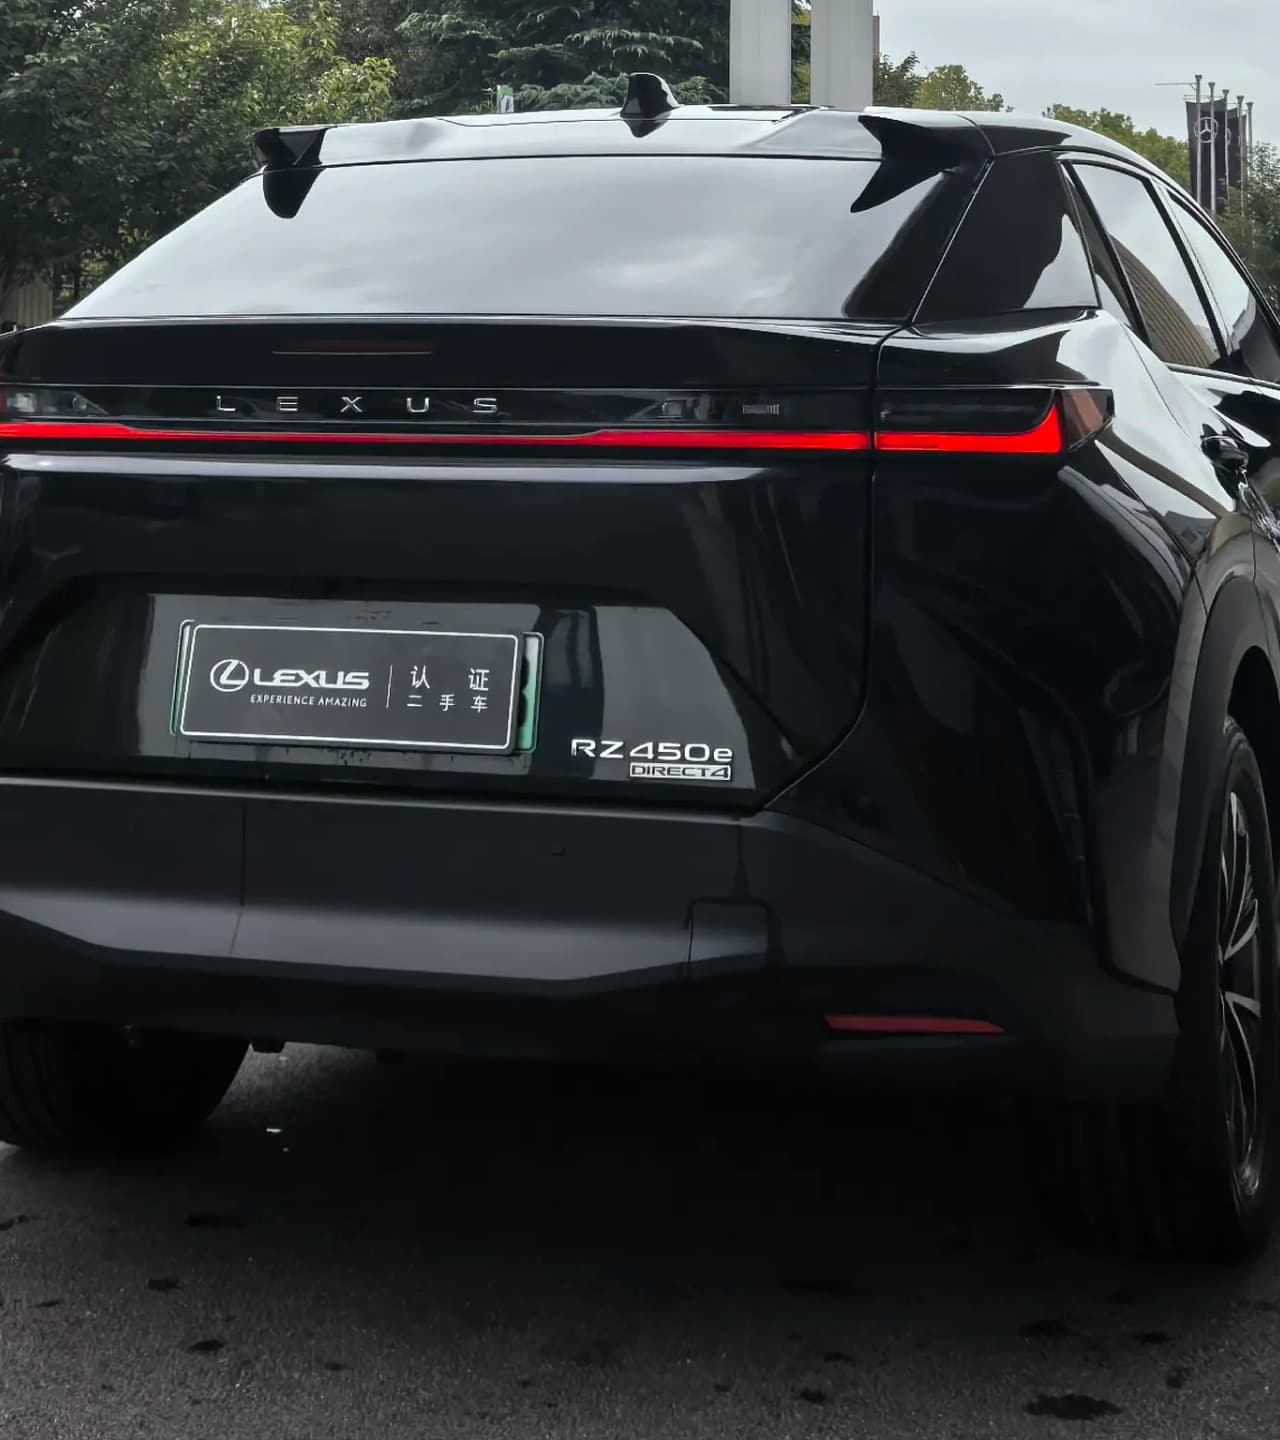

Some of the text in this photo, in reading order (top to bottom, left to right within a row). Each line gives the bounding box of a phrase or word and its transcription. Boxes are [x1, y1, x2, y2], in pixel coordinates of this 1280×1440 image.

[216, 395, 498, 414] LEXUS
[253, 668, 370, 690] LEXUS
[250, 694, 367, 708] EXPERIENCE AMAZING
[406, 693, 489, 713] 二手车
[631, 764, 729, 779] DIRECT4
